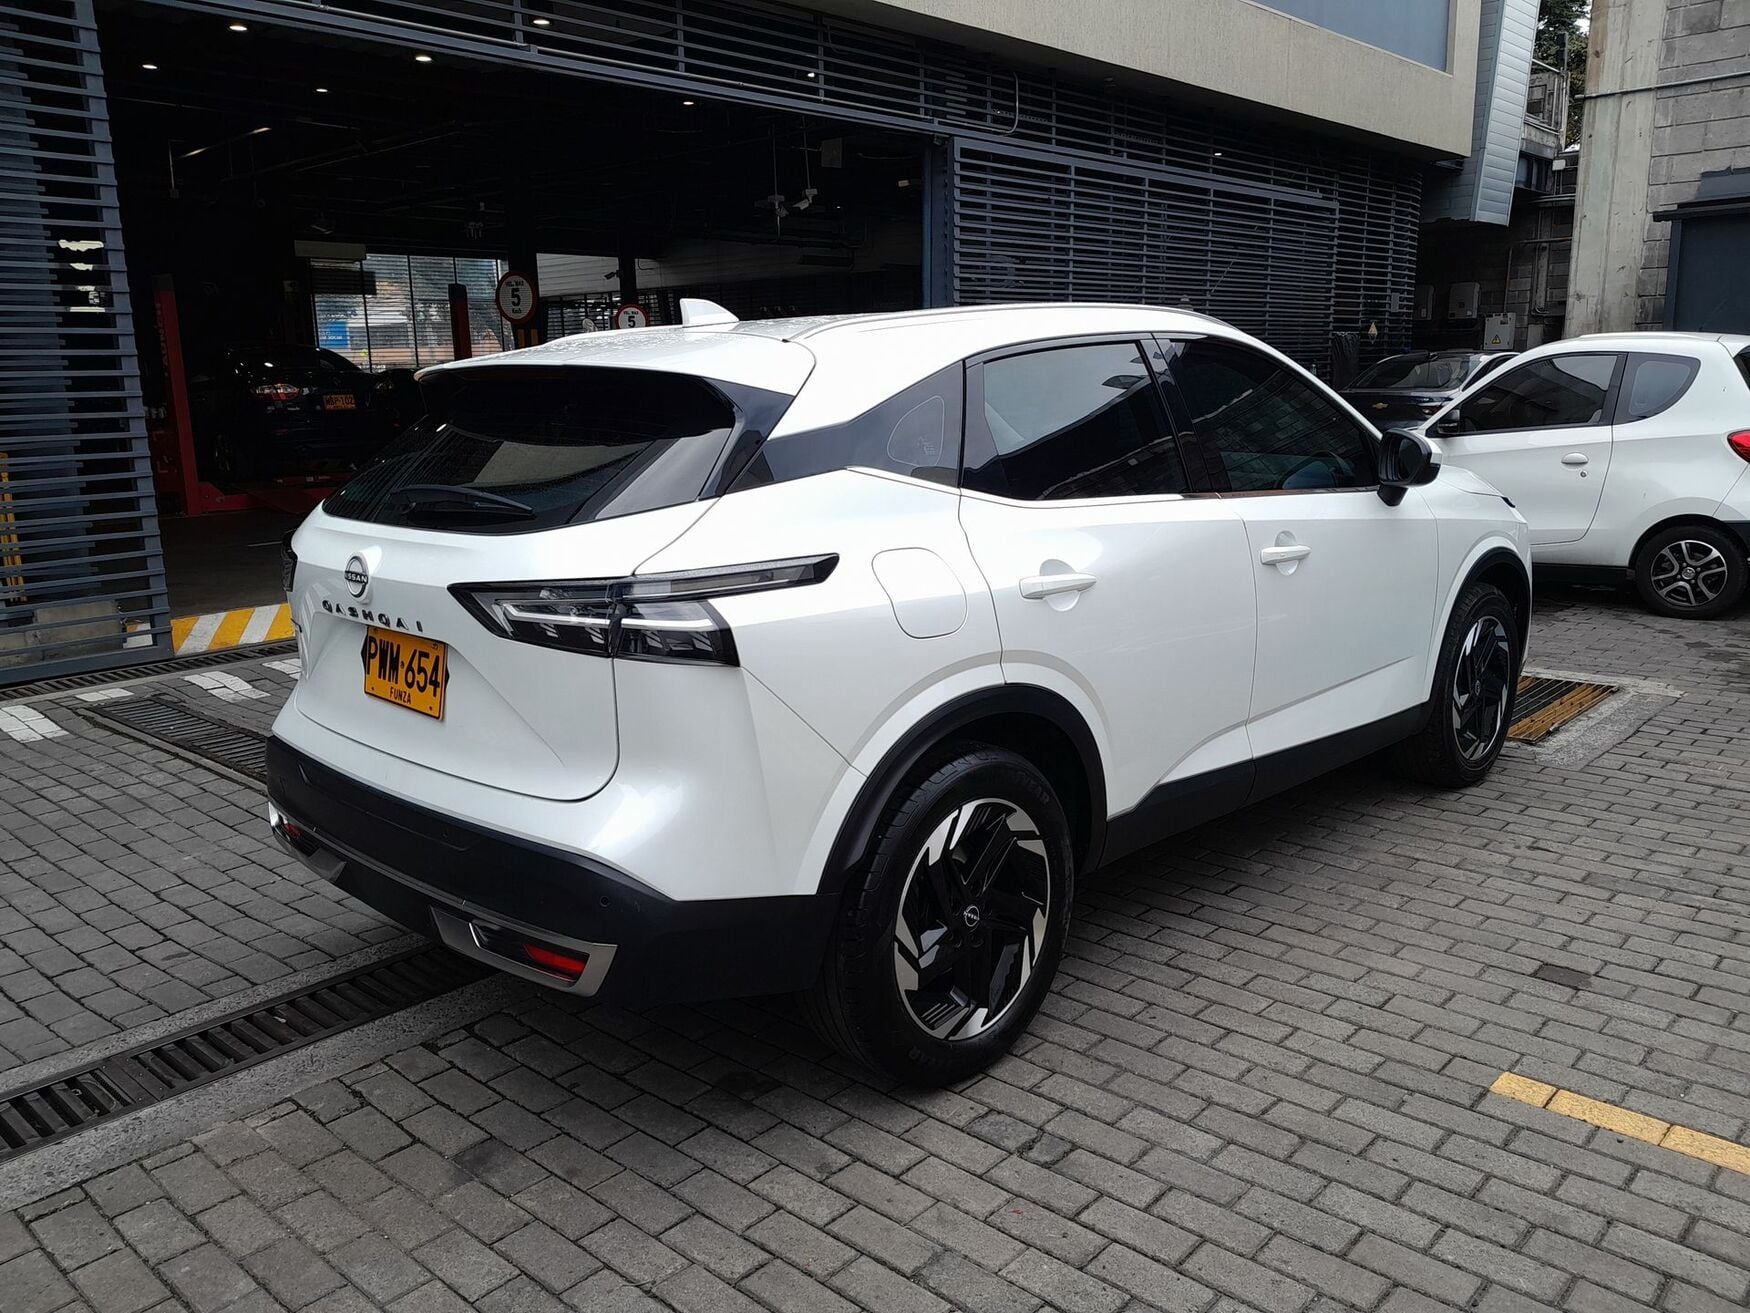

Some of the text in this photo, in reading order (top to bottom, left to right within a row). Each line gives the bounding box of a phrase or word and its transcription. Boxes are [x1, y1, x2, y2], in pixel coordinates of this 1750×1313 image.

[511, 287, 521, 307] 5
[628, 315, 636, 328] 5
[345, 571, 368, 583] SSAN
[322, 600, 423, 632] QASHQAI
[390, 686, 412, 705] FUNZA
